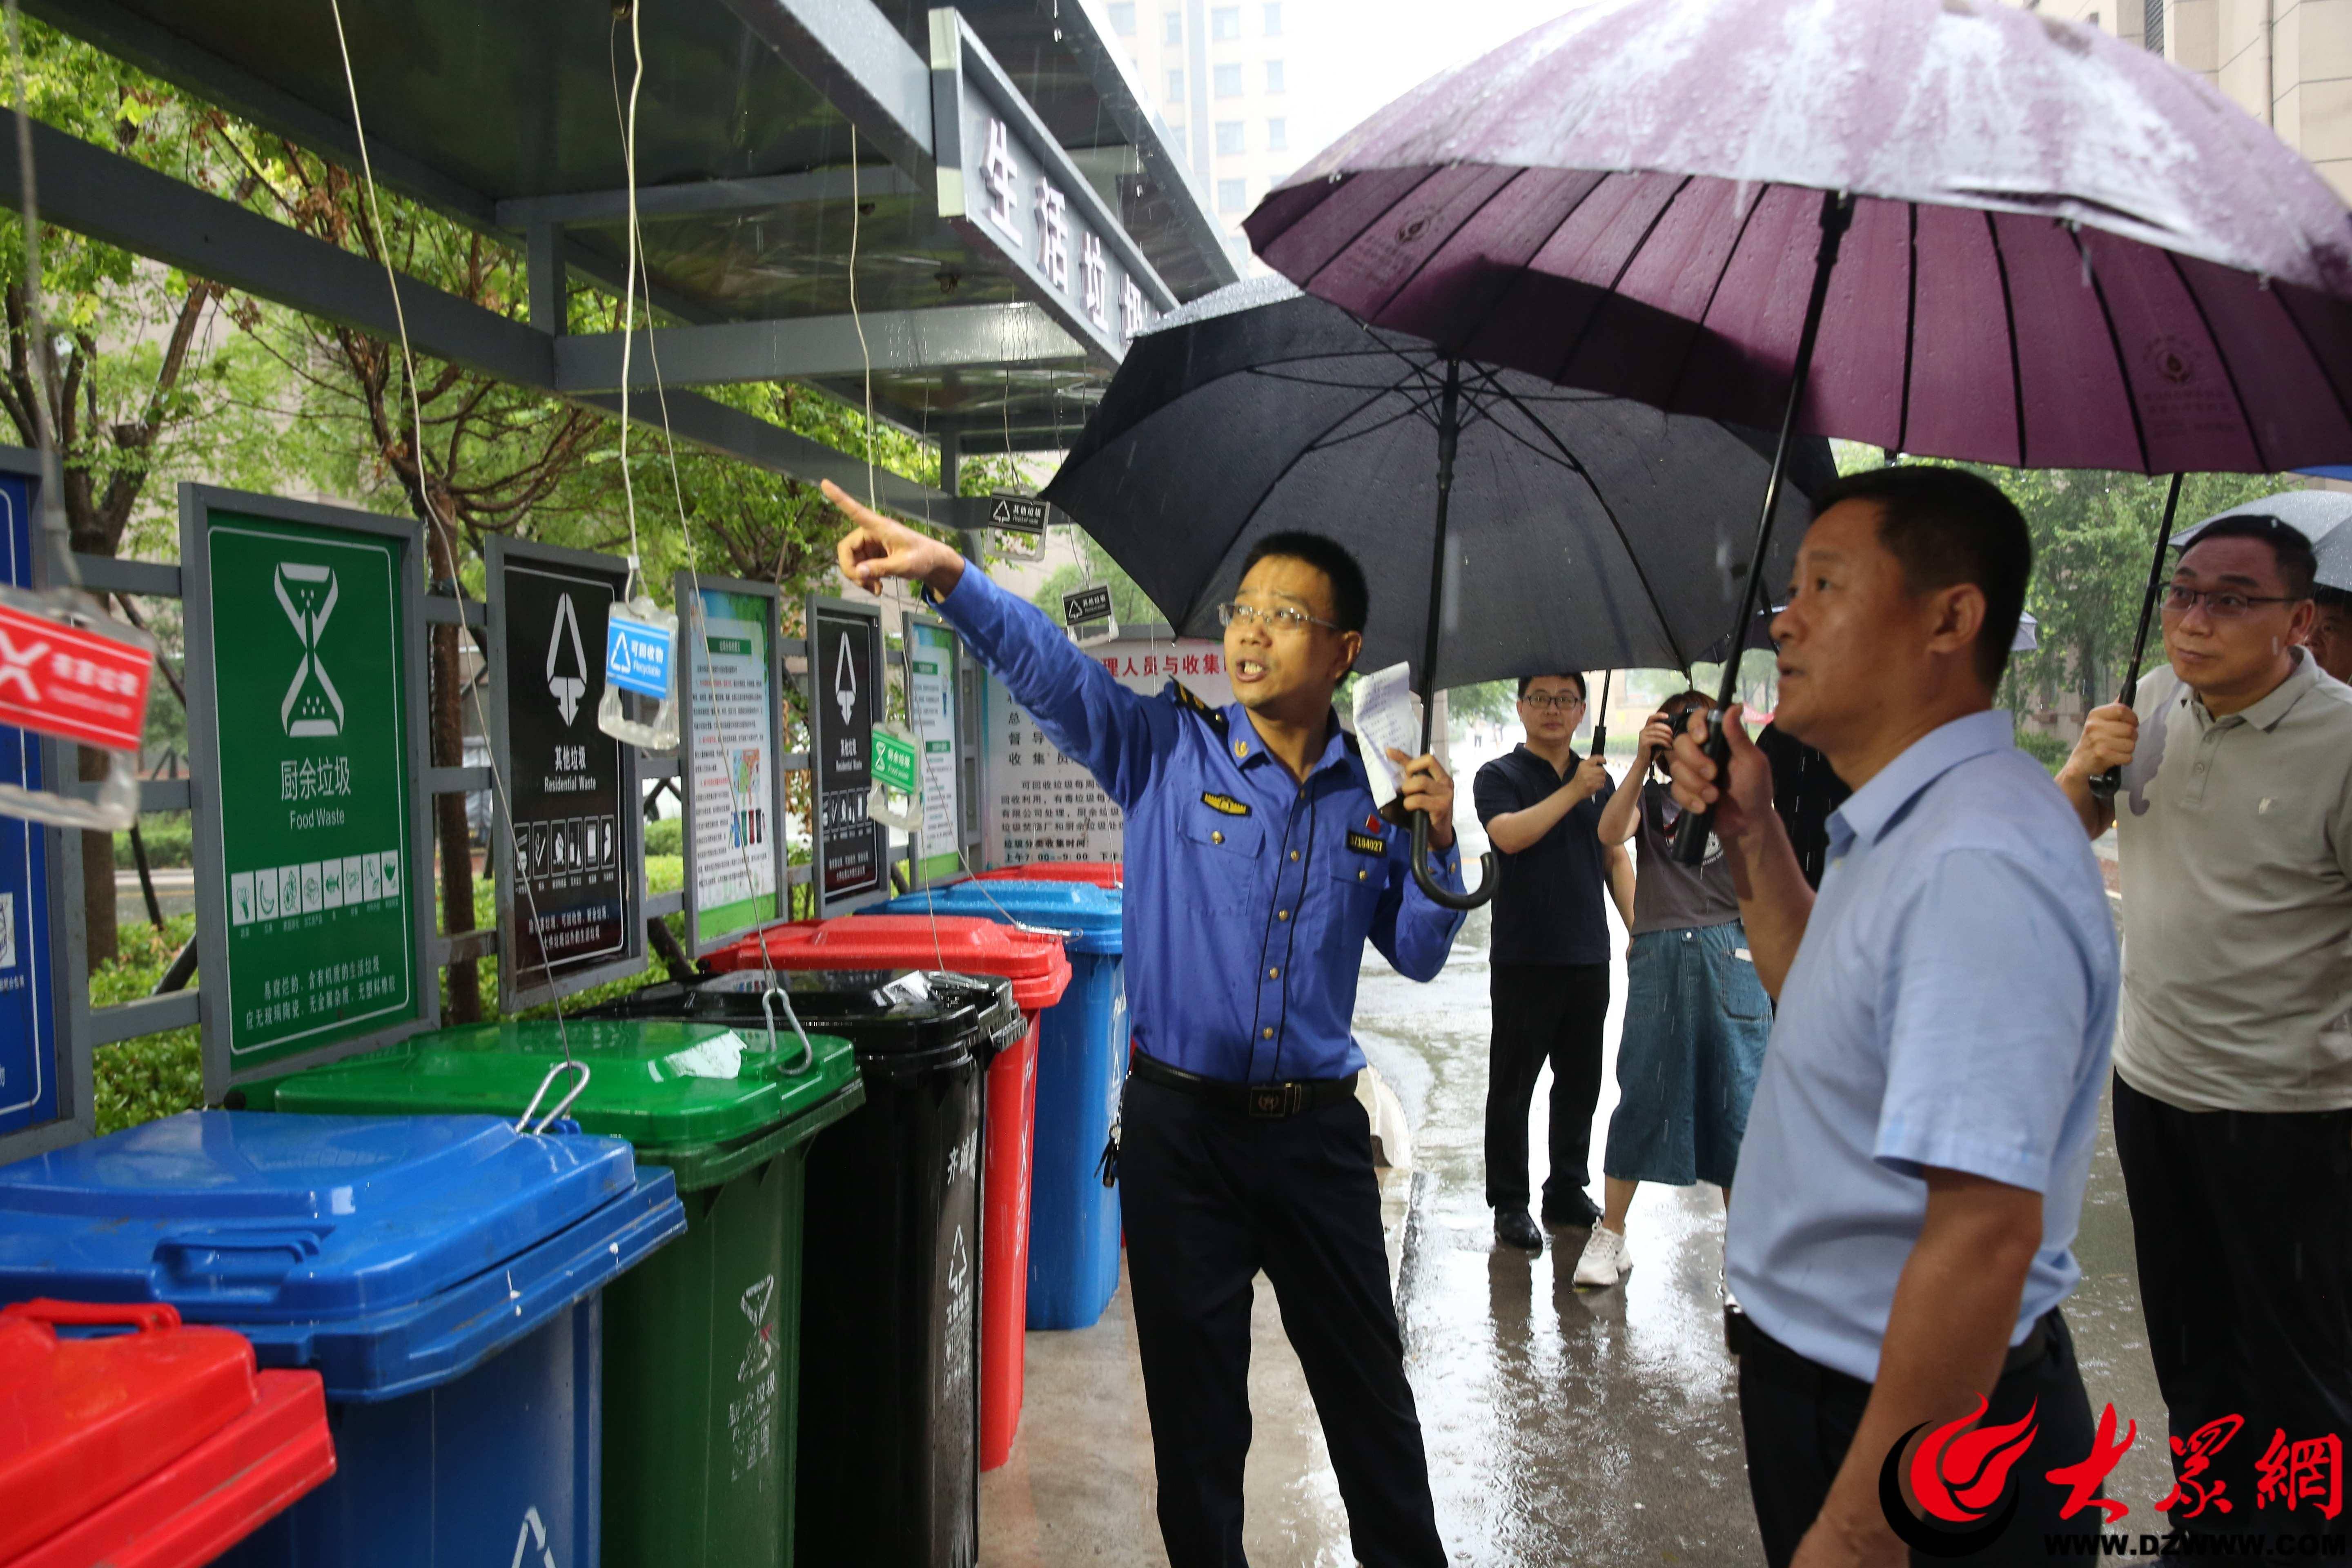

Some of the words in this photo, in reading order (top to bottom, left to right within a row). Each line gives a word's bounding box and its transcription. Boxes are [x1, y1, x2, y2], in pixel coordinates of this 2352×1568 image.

[980, 118, 1160, 345] 生活垃圾
[631, 639, 664, 664] 可回收物
[1094, 653, 1227, 678] 理人员与收集
[555, 745, 586, 772] 其他垃圾
[888, 748, 911, 769] 厨余垃圾
[281, 755, 351, 802] 厨余垃圾
[545, 775, 577, 793] Residential
[579, 774, 596, 791] Waste
[1022, 779, 1100, 790] 可回收垃圾每周
[290, 809, 314, 830] Food
[316, 807, 345, 827] Waste
[1100, 851, 1123, 862] 下午
[728, 1369, 775, 1428] 厨余垃圾
